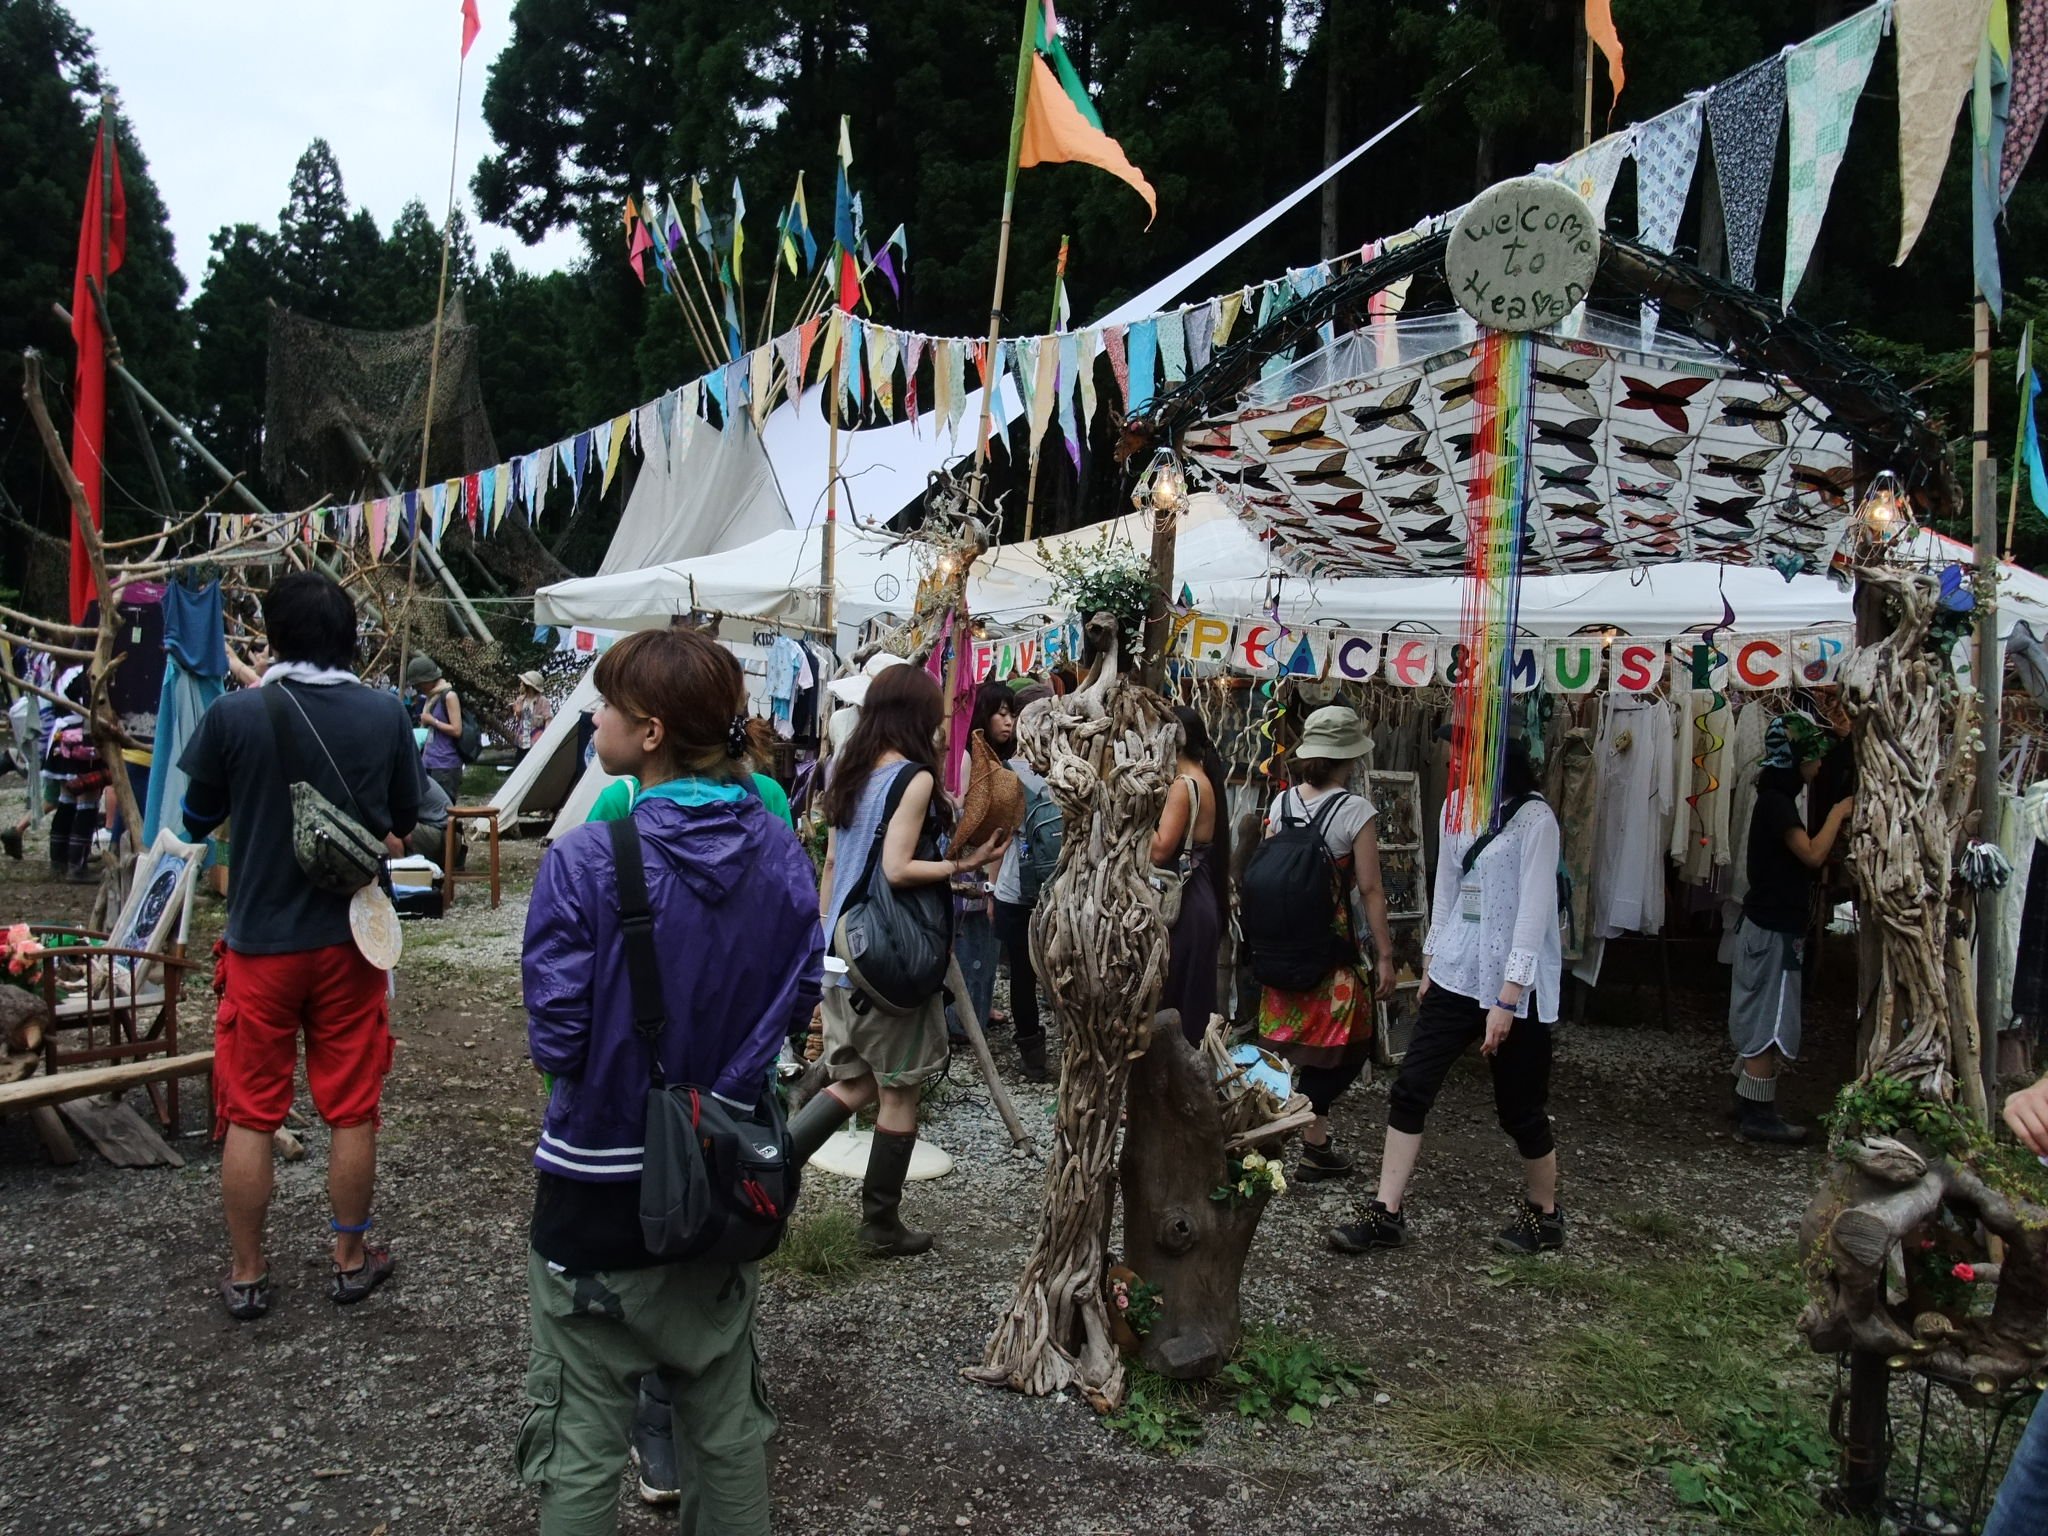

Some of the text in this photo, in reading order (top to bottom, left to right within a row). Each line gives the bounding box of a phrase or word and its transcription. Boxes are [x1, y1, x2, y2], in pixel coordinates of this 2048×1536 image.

[1502, 235, 1546, 275] to
[1190, 618, 1427, 686] PEACE
[1497, 640, 1783, 691] MUSIC
